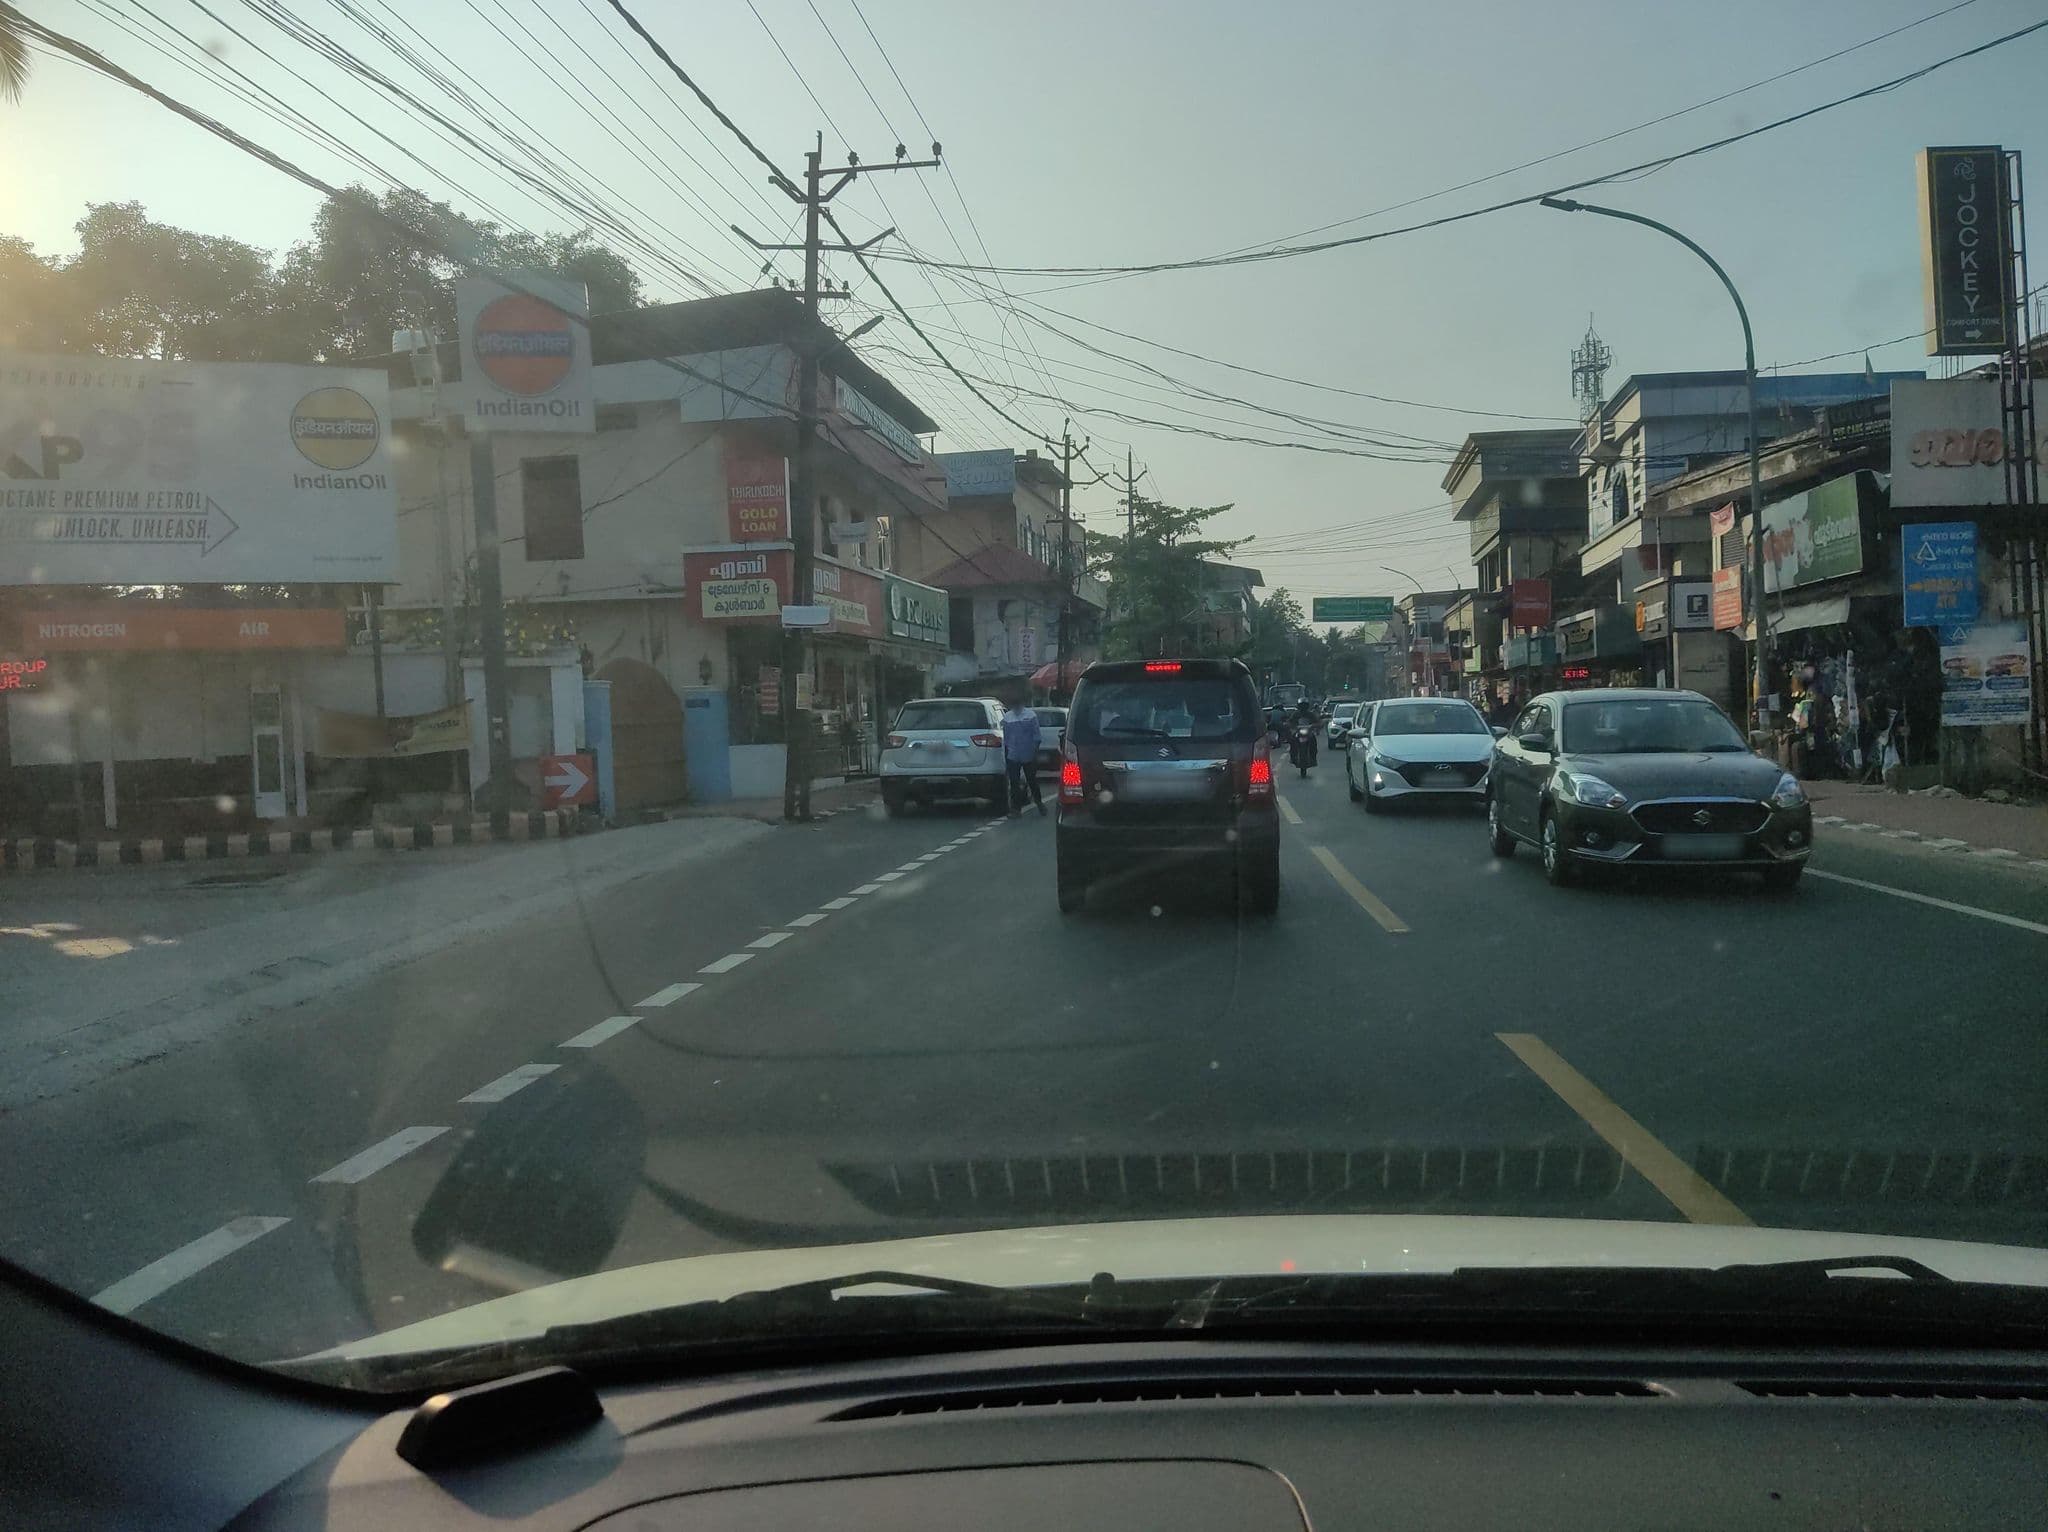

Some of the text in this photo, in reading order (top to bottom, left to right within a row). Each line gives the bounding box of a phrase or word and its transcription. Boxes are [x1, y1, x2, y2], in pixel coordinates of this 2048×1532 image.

[1956, 184, 1980, 313] JOCKEY
[476, 398, 580, 417] IndianOil
[293, 473, 388, 489] IndianOil
[730, 483, 785, 499] THIRUKOCHI
[64, 490, 138, 509] PREMIUM
[145, 491, 202, 509] PETROL
[739, 507, 778, 520] GOLD
[53, 517, 124, 538] UNLOCK.
[132, 518, 211, 538] UNLEASH.
[741, 520, 777, 533] LOAN
[39, 621, 270, 638] NITROGEN AIR
[0, 659, 48, 674] ROUP
